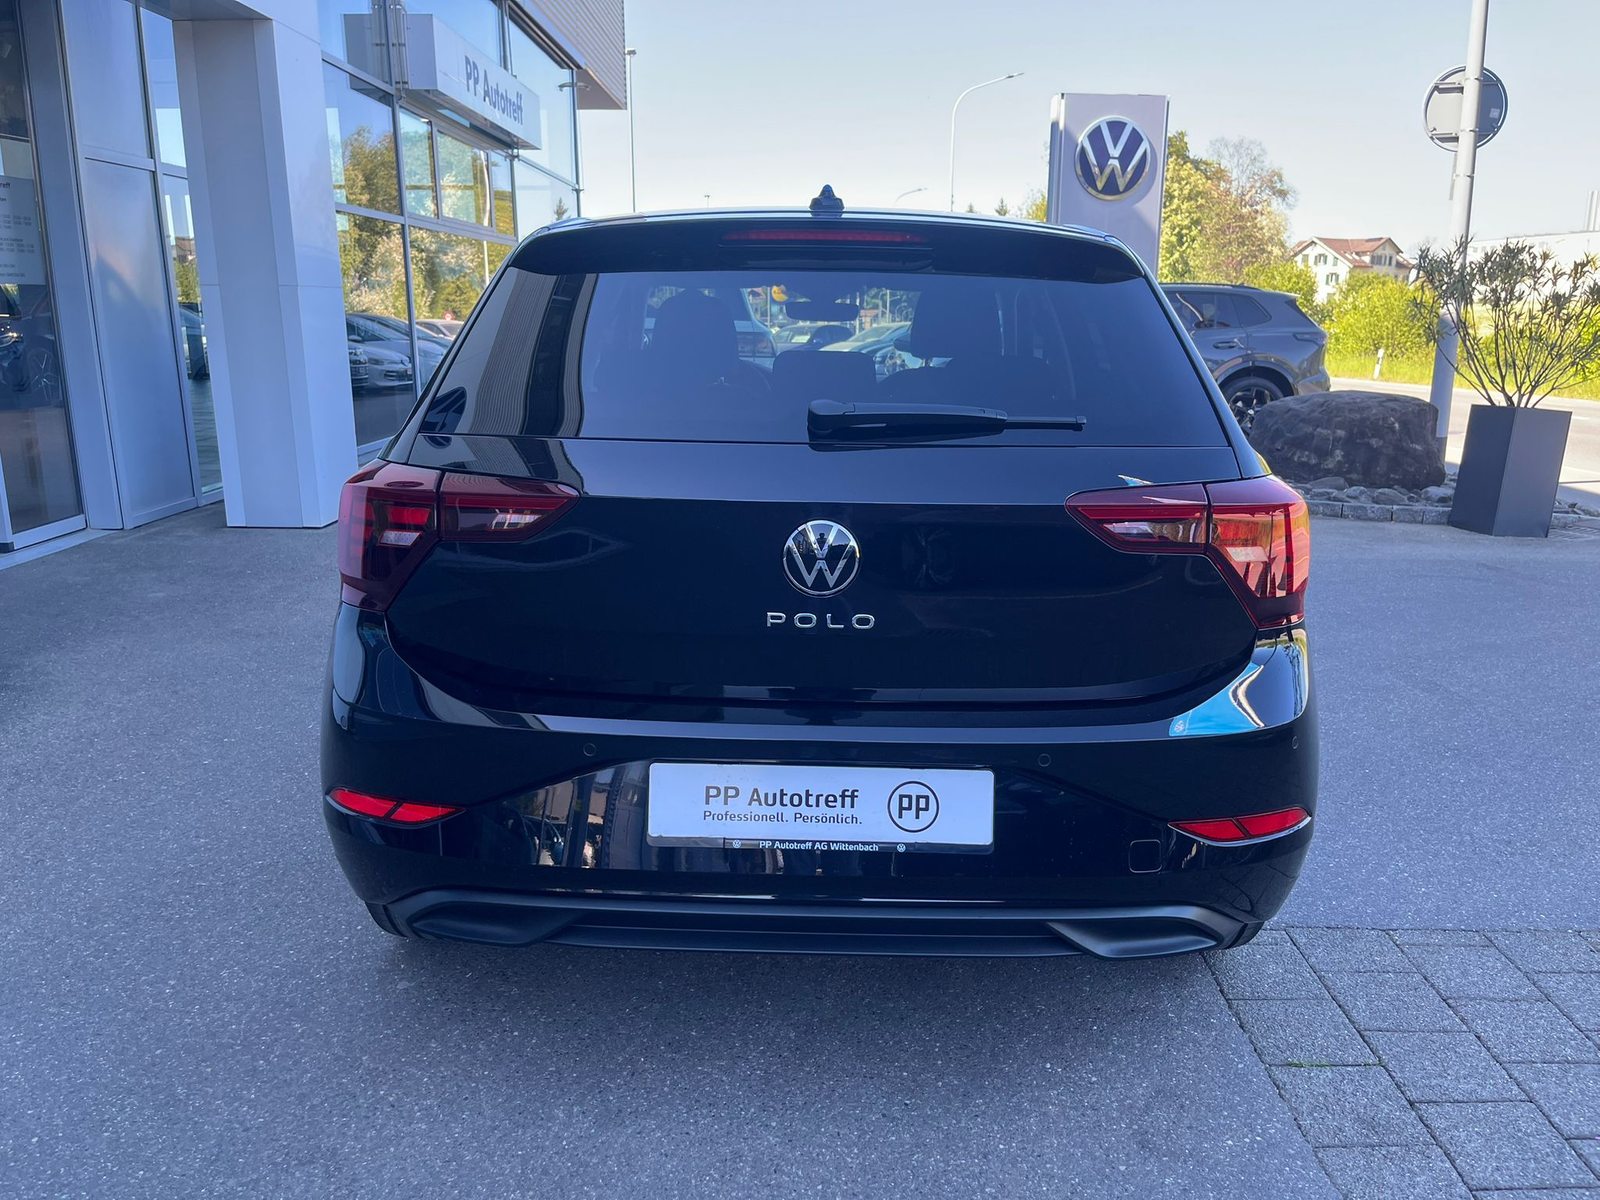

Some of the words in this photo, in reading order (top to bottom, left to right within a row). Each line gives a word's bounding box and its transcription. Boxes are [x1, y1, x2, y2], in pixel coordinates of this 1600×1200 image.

[464, 55, 479, 96] PP
[483, 69, 523, 125] Autotreff
[1076, 115, 1150, 200] VW
[784, 520, 860, 596] VW
[766, 611, 876, 630] POLO
[704, 785, 740, 806] PP
[747, 787, 860, 809] Autotreff
[703, 810, 789, 823] Professionell.
[794, 812, 863, 825] Persönlich.
[759, 840, 772, 849] PP
[774, 841, 812, 850] Autotreff
[815, 842, 828, 850] AG
[830, 842, 879, 852] Wittenbach
